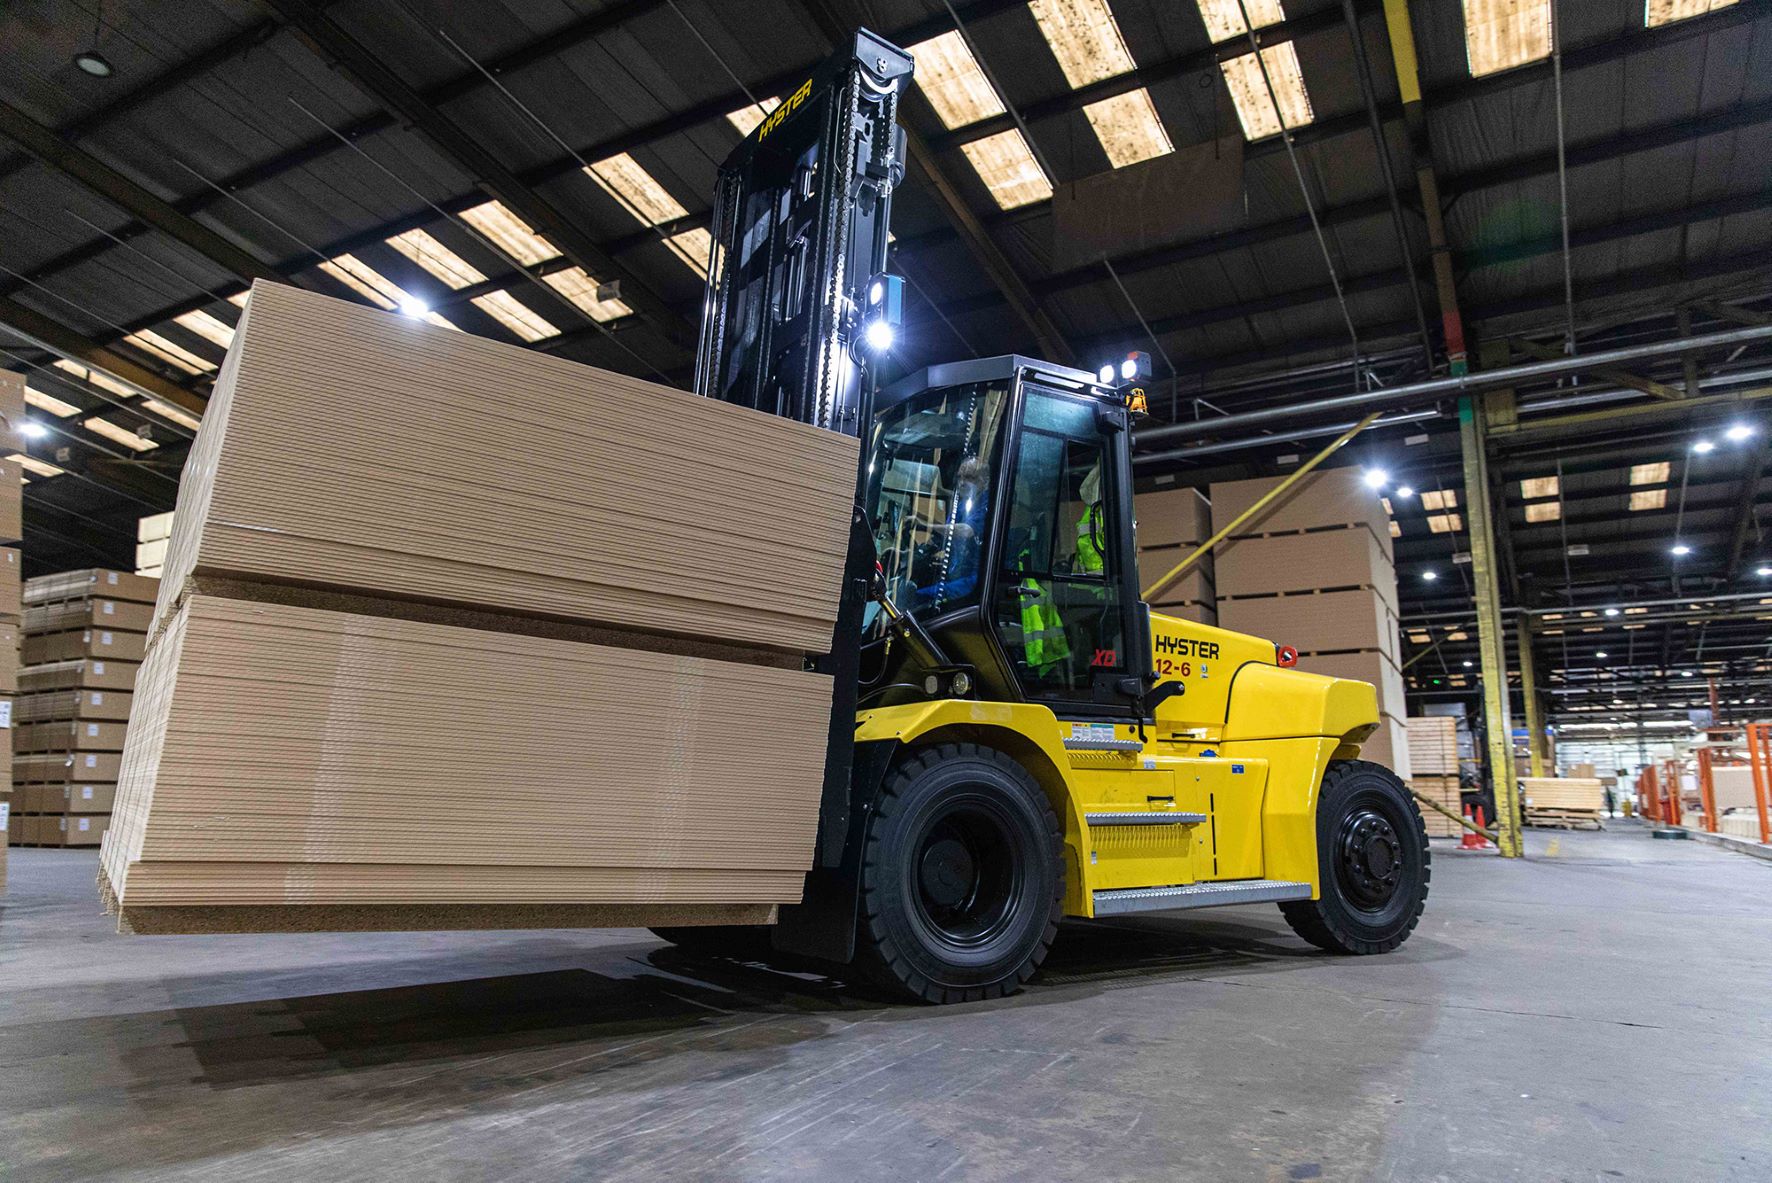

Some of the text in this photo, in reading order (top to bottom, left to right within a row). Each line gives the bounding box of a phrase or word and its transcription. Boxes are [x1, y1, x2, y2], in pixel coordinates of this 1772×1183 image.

[758, 78, 813, 143] HYSTER
[1092, 649, 1116, 667] XD
[1155, 634, 1220, 660] HYSTER
[1155, 659, 1191, 677] 12-6
